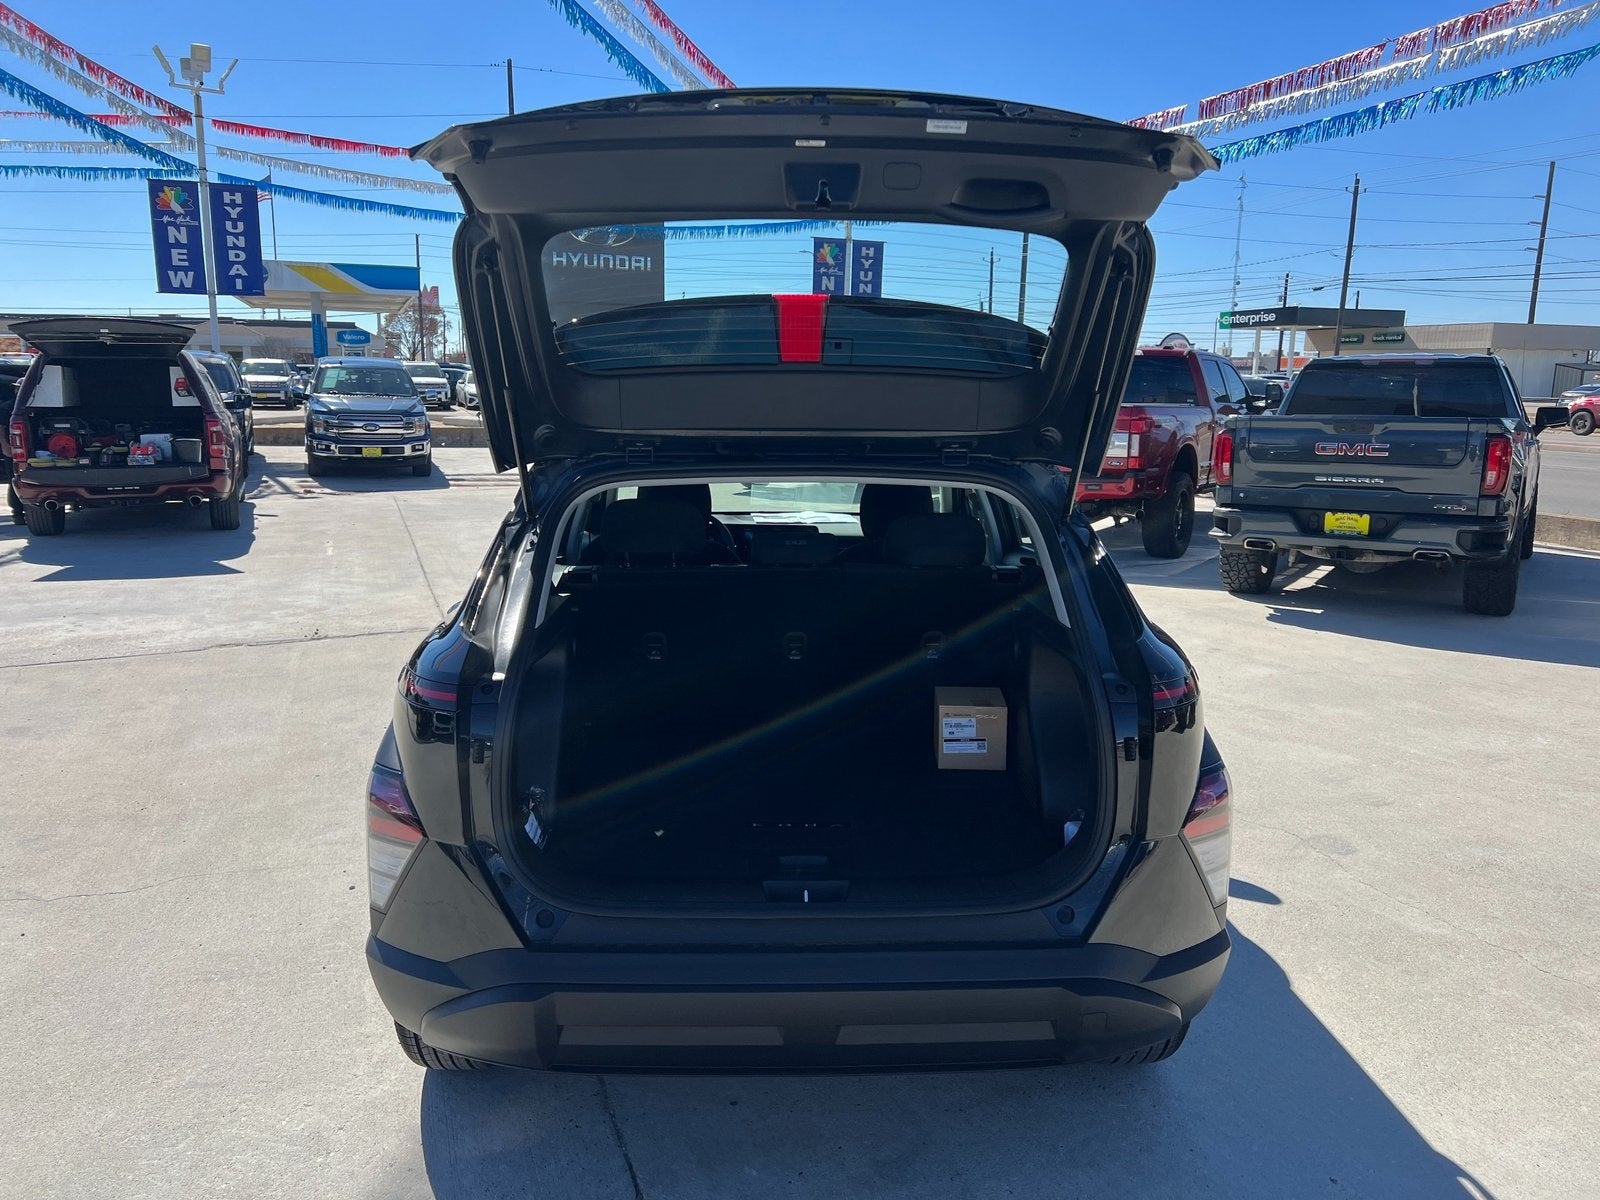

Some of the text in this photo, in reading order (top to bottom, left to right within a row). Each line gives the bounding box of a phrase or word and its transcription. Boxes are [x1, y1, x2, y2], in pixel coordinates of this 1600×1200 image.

[222, 191, 249, 290] HYUNDAI
[167, 226, 195, 288] NEW
[552, 251, 653, 272] HYUNDAI
[1222, 311, 1277, 326] enterprise
[342, 333, 366, 341] Valero
[1314, 442, 1390, 457] GMC
[1314, 475, 1384, 484] SIERRA
